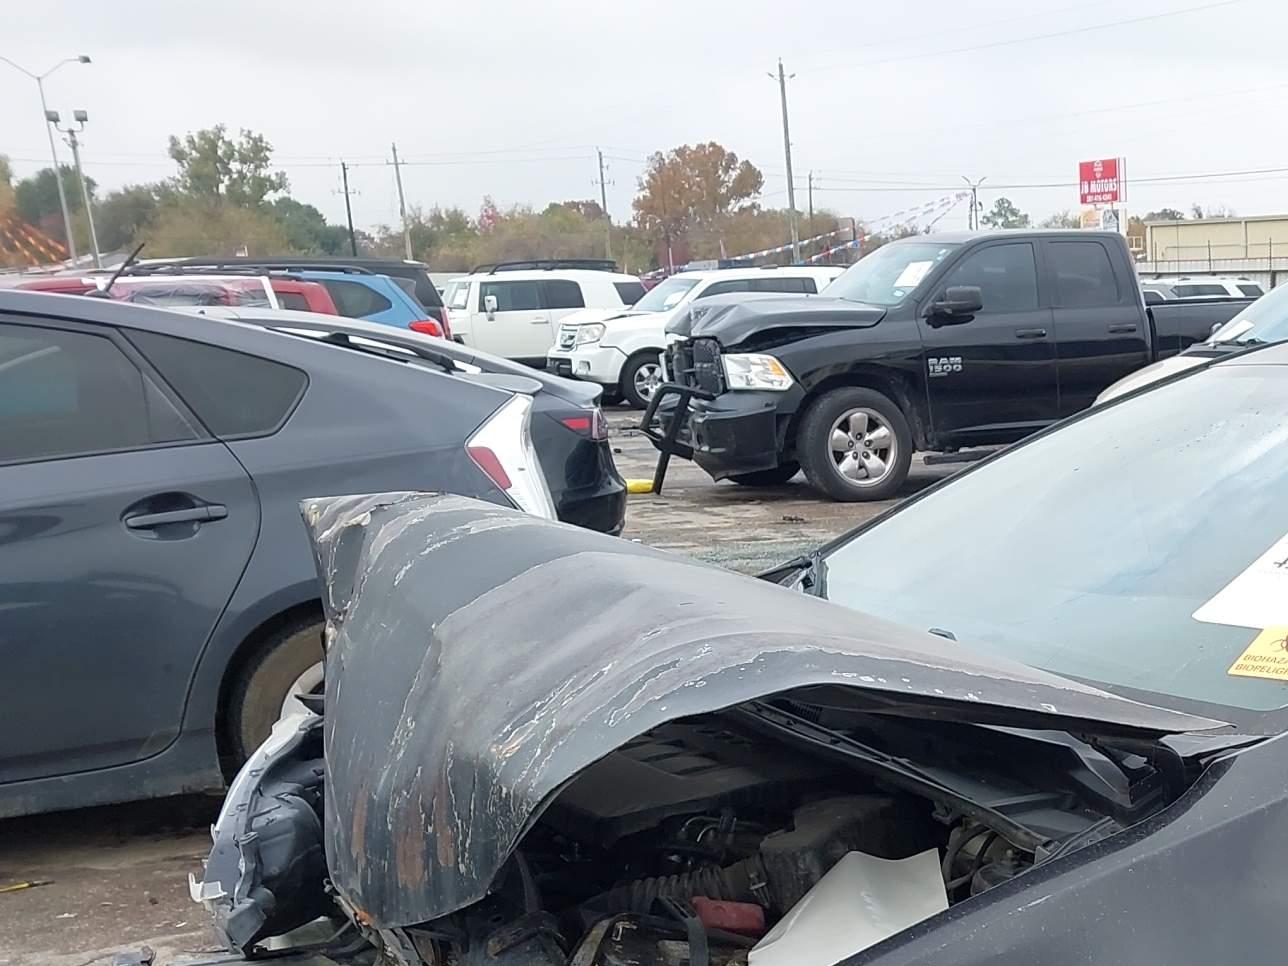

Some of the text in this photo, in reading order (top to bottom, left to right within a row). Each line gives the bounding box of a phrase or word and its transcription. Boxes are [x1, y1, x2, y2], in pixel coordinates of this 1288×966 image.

[1090, 177, 1117, 193] MOTORS
[928, 357, 962, 365] RAM
[929, 364, 962, 372] 1500
